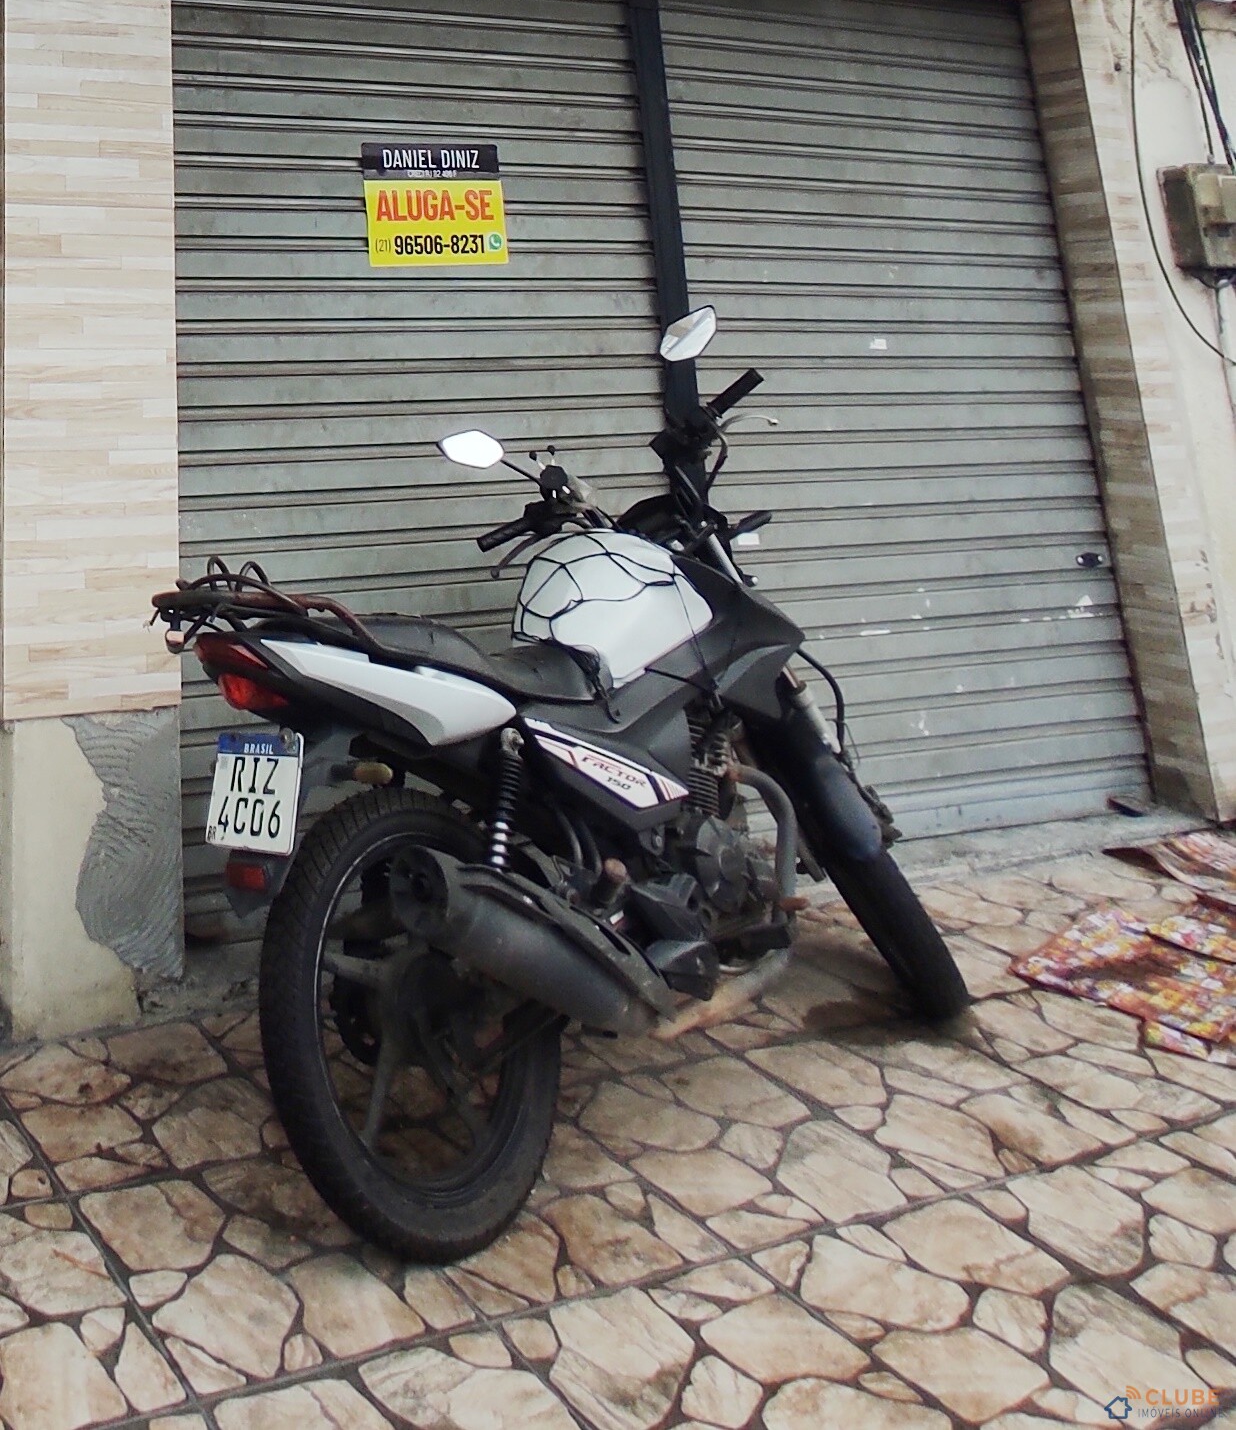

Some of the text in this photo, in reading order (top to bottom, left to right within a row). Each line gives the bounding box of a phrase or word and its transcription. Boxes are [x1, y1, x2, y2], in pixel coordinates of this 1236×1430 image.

[382, 149, 480, 169] DANIEL DINIZ
[376, 189, 495, 222] ALUGA-SE
[375, 234, 485, 255] (21) 96506-8231
[243, 743, 274, 755] BRASIL
[230, 756, 279, 795] RIZ
[581, 754, 647, 788] FACTOR
[605, 776, 631, 791] 150
[217, 796, 281, 839] 4C06
